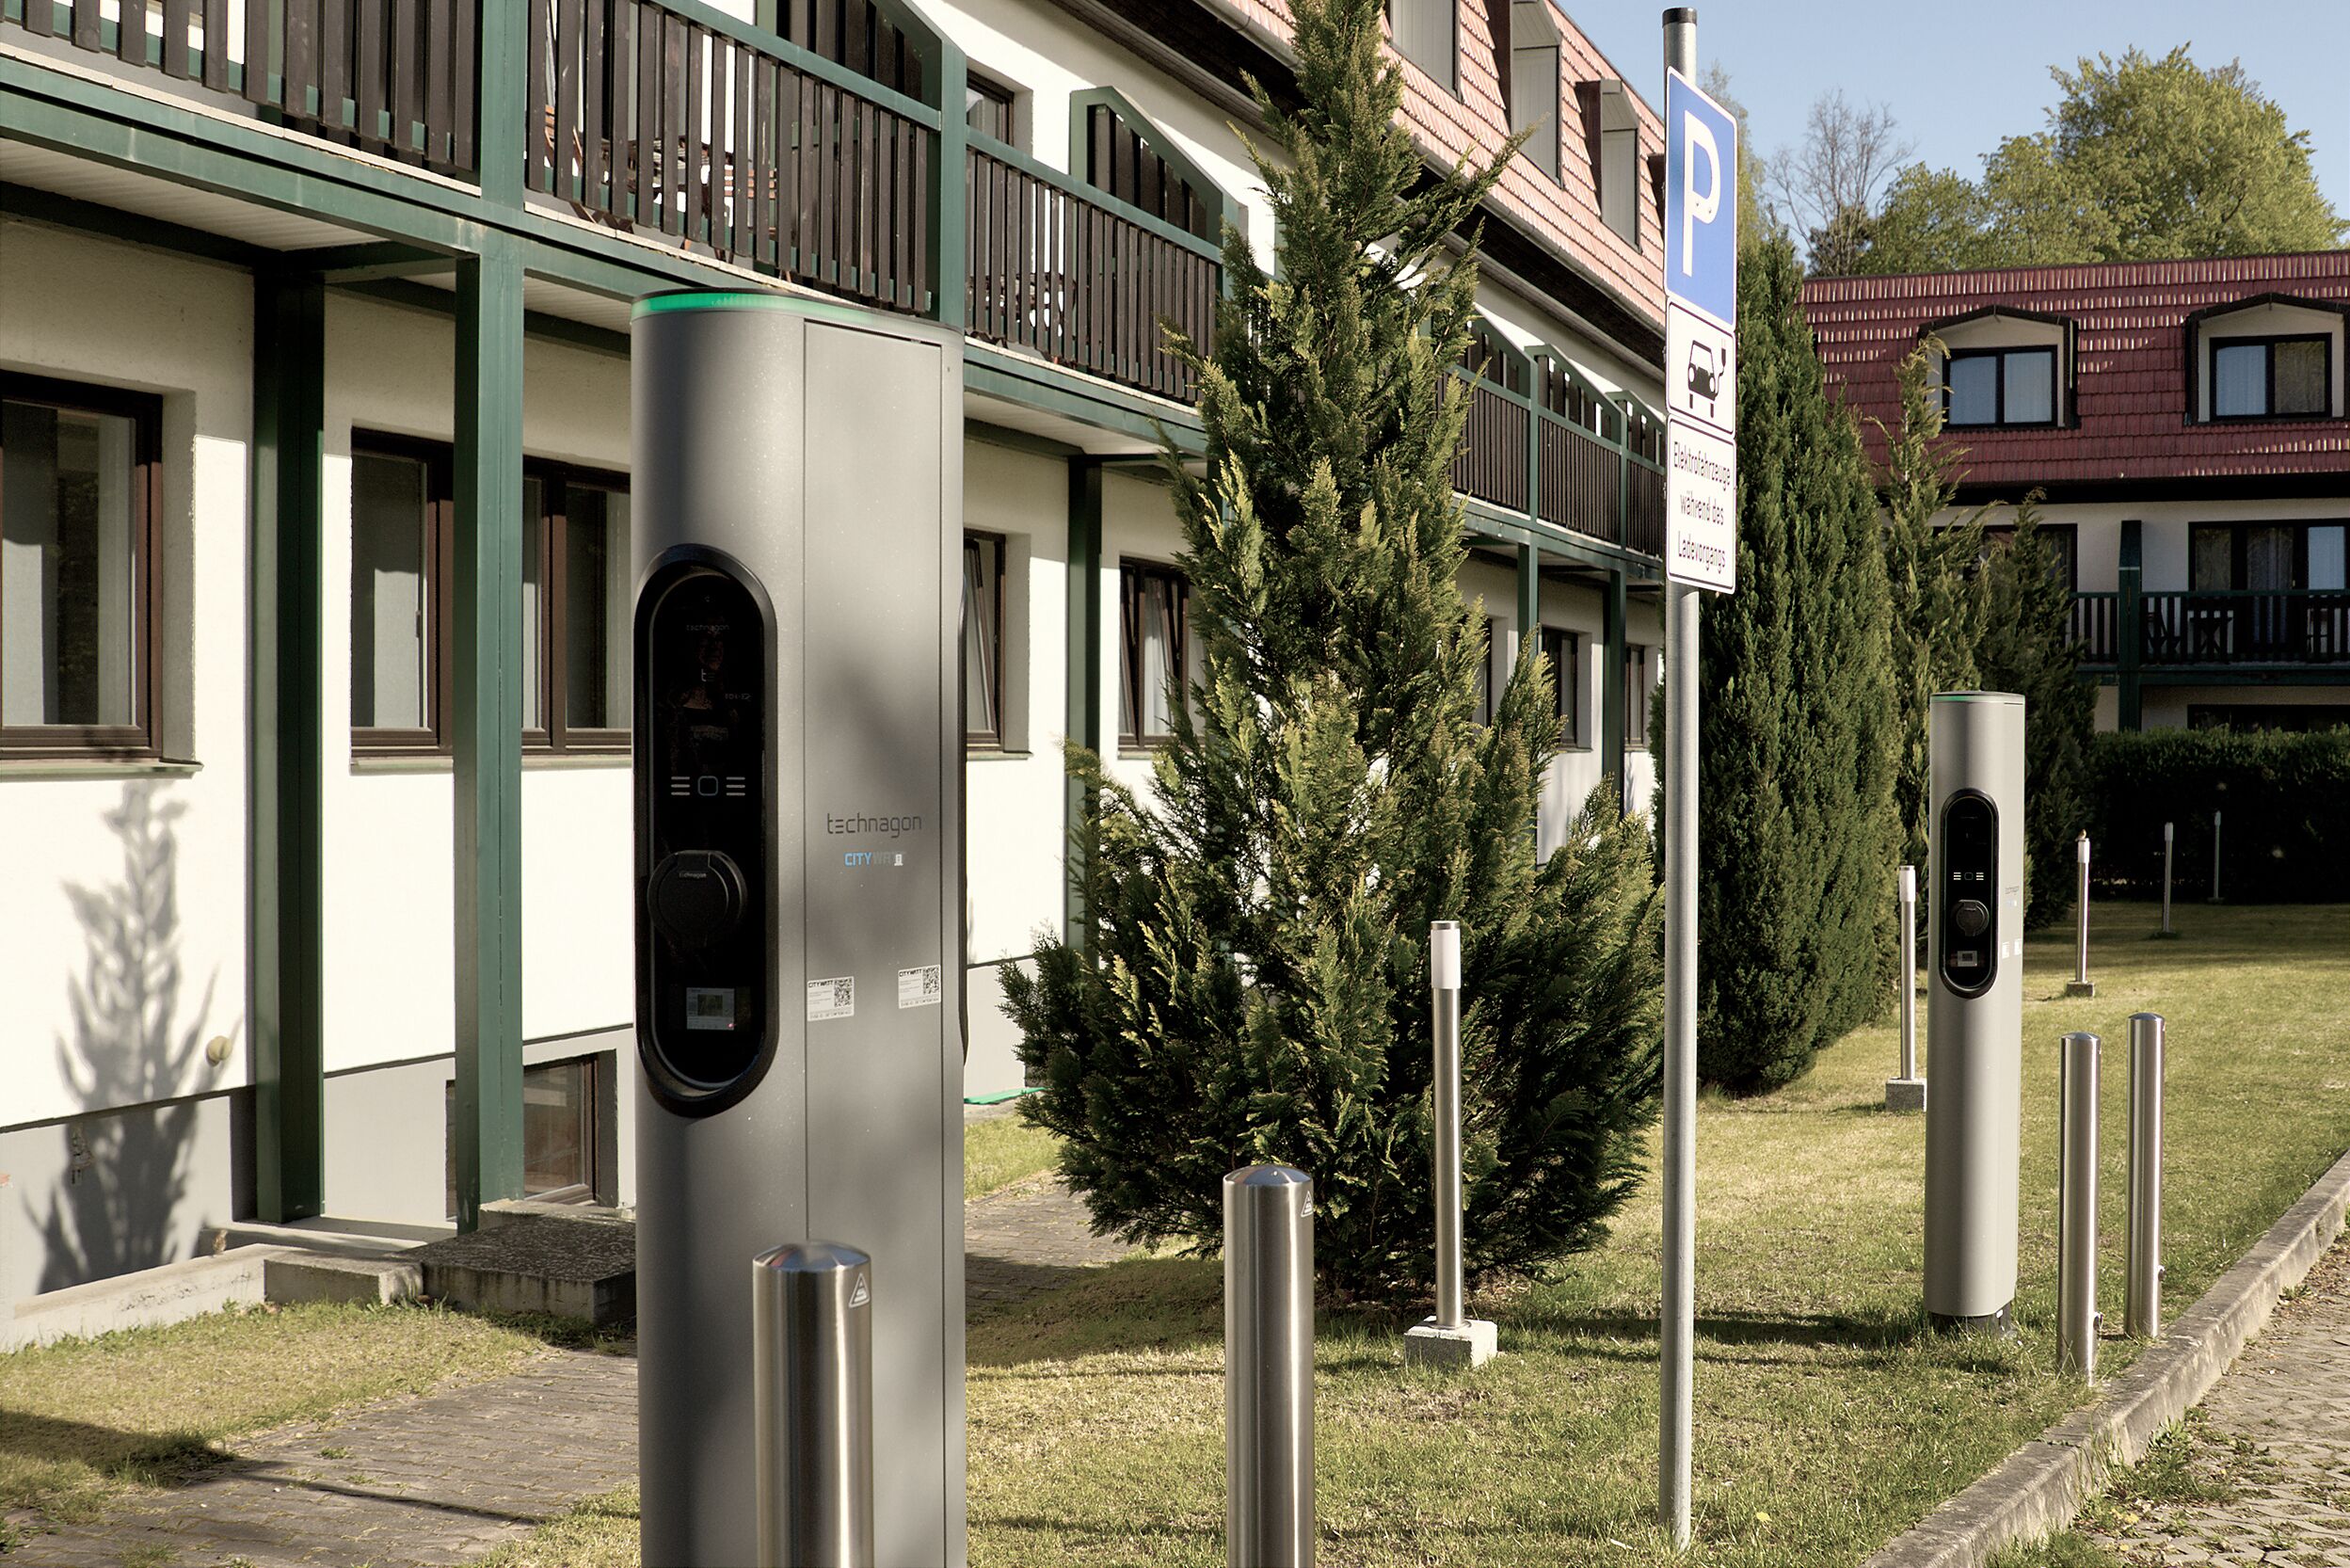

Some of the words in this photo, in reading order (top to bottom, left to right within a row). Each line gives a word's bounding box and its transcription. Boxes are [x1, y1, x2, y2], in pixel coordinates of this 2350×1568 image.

[1683, 109, 1721, 278] P
[1673, 440, 1731, 491] Elektrofahrzeuge
[1680, 490, 1710, 520] während
[1712, 500, 1724, 525] des
[1678, 530, 1726, 573] Ladevorgangs
[827, 812, 922, 838] technagon
